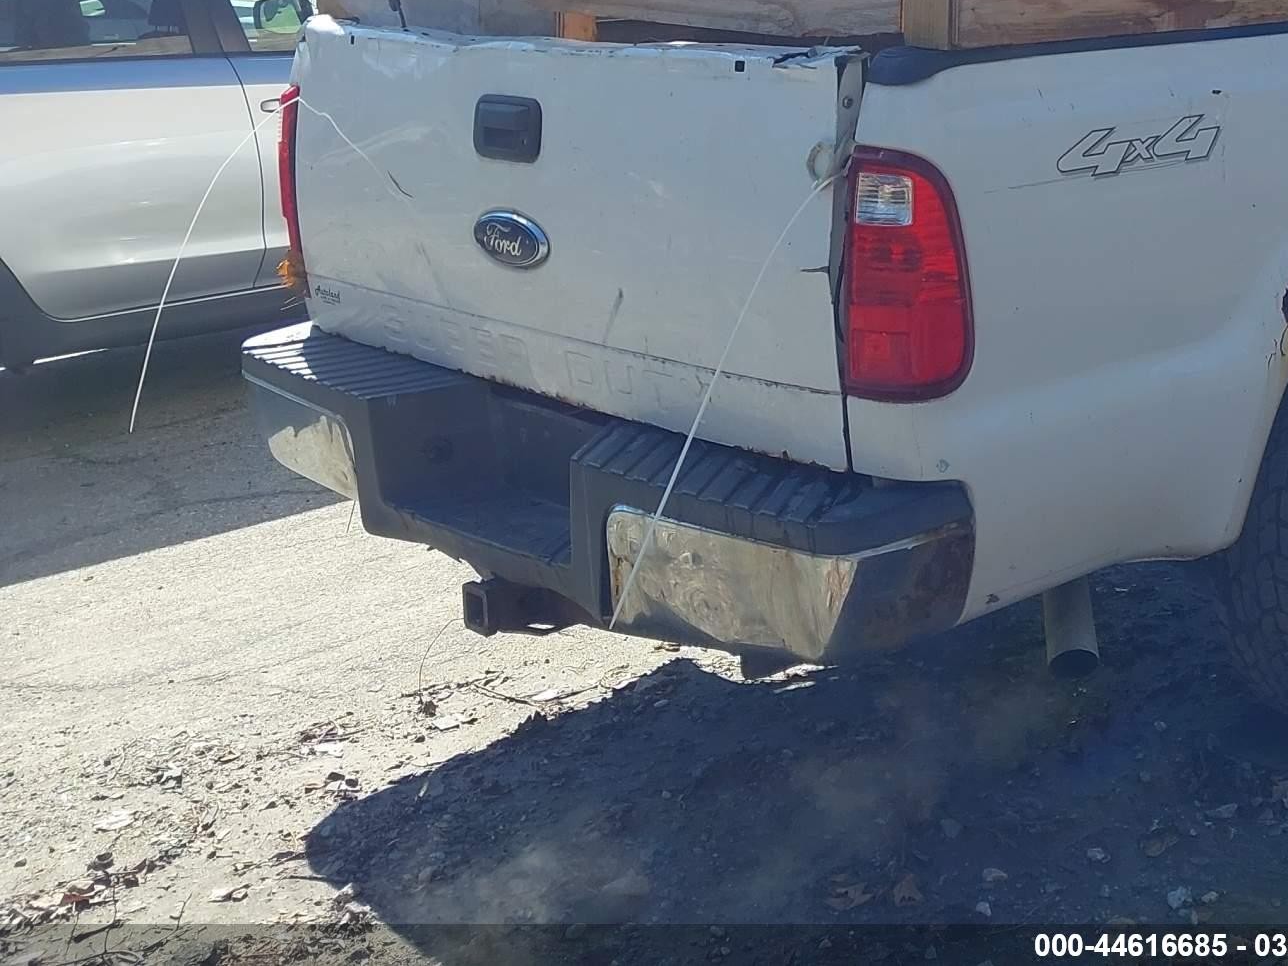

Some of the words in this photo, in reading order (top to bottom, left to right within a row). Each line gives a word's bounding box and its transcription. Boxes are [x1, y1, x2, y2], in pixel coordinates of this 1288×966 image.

[1056, 113, 1221, 178] 4x4
[483, 221, 523, 256] Ford
[379, 303, 539, 381] SUPER
[564, 349, 722, 422] DUTY
